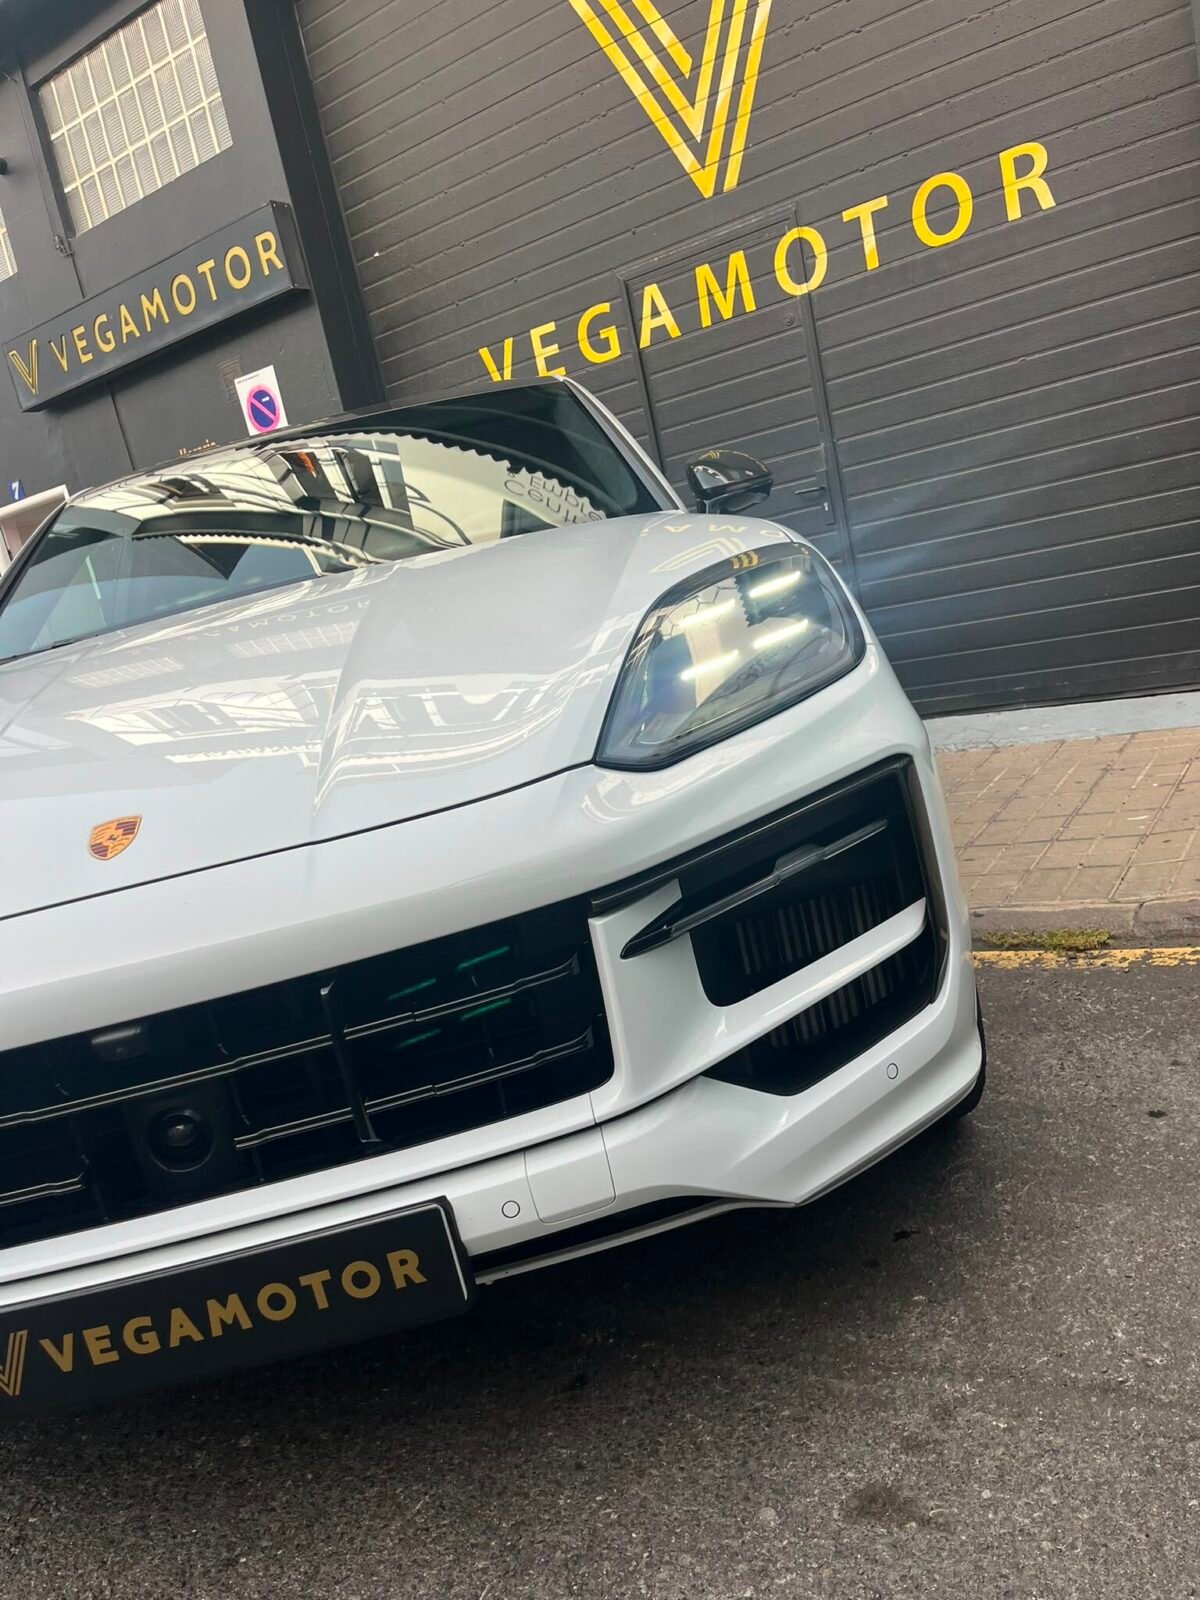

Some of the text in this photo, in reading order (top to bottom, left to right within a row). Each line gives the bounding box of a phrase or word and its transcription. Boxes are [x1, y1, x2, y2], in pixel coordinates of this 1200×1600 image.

[48, 231, 284, 373] VEGAMOTOR
[478, 141, 1057, 382] VEGAMOTOR
[11, 480, 20, 500] 7
[38, 1249, 429, 1373] VEGAMOTOR
